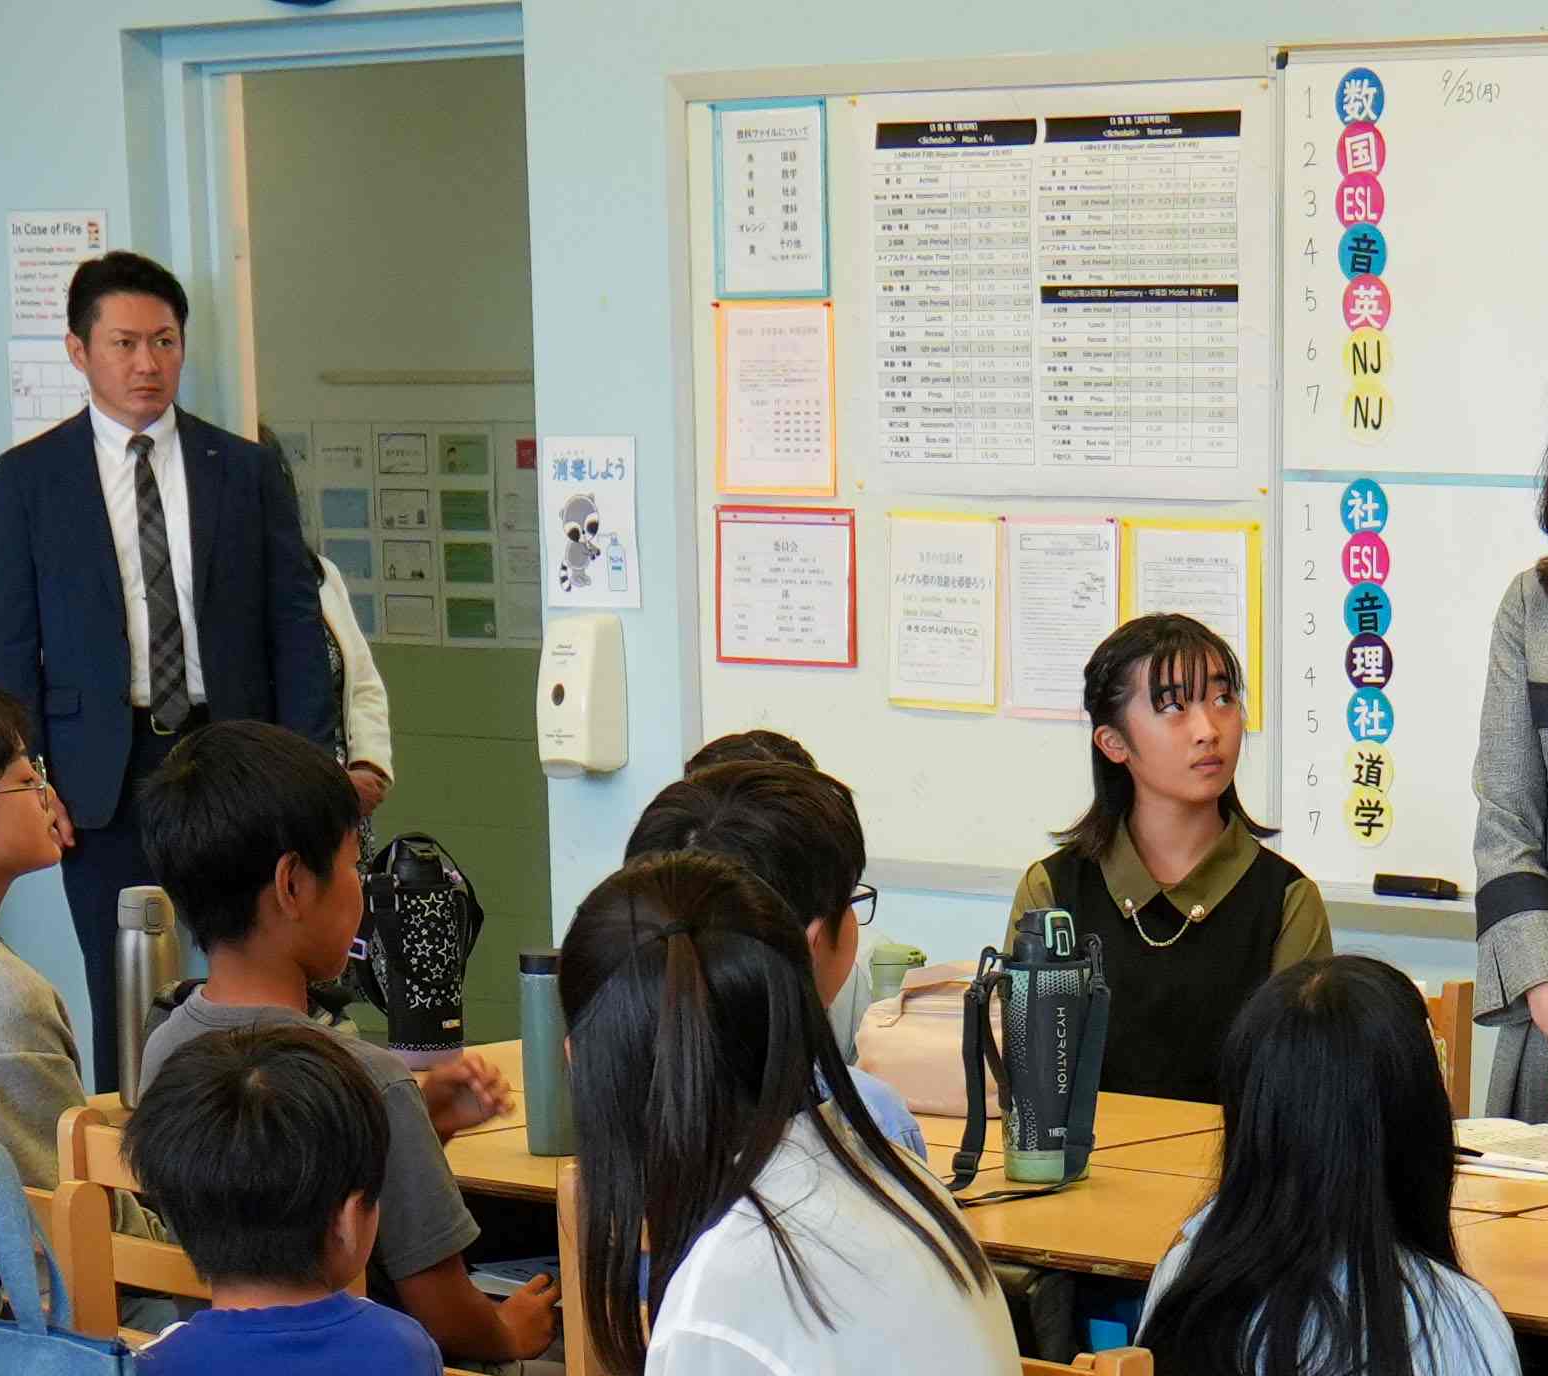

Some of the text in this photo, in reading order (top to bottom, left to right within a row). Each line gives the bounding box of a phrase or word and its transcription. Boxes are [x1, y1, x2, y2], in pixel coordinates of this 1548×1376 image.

[1343, 79, 1377, 121] 数
[1303, 143, 1316, 166] 2
[1345, 132, 1378, 173] 国
[1304, 191, 1317, 217] 3
[1343, 187, 1377, 220] ESL
[24, 223, 47, 236] Case
[51, 223, 60, 235] of
[63, 222, 82, 235] Fire
[1303, 237, 1318, 264] 4
[1348, 234, 1379, 274] 音
[1305, 287, 1317, 312] 5
[1350, 285, 1382, 328] 英
[1307, 339, 1317, 361] 6
[1352, 340, 1382, 375] NJ
[1306, 385, 1320, 414] 7
[1354, 395, 1384, 430] NJ
[1348, 490, 1381, 530] 社
[1303, 559, 1316, 580] 2
[1349, 546, 1384, 579] ESL
[1303, 612, 1315, 635] 3
[1353, 592, 1383, 633] 音
[1303, 666, 1316, 687] 4
[1352, 645, 1386, 684] 理
[1307, 710, 1318, 733] 5
[1354, 698, 1387, 737] 社
[1306, 763, 1317, 786] 6
[1354, 752, 1384, 792] 道
[1308, 810, 1320, 834] 7
[1354, 798, 1384, 837] 学
[1056, 1006, 1068, 1094] HYDRATION
